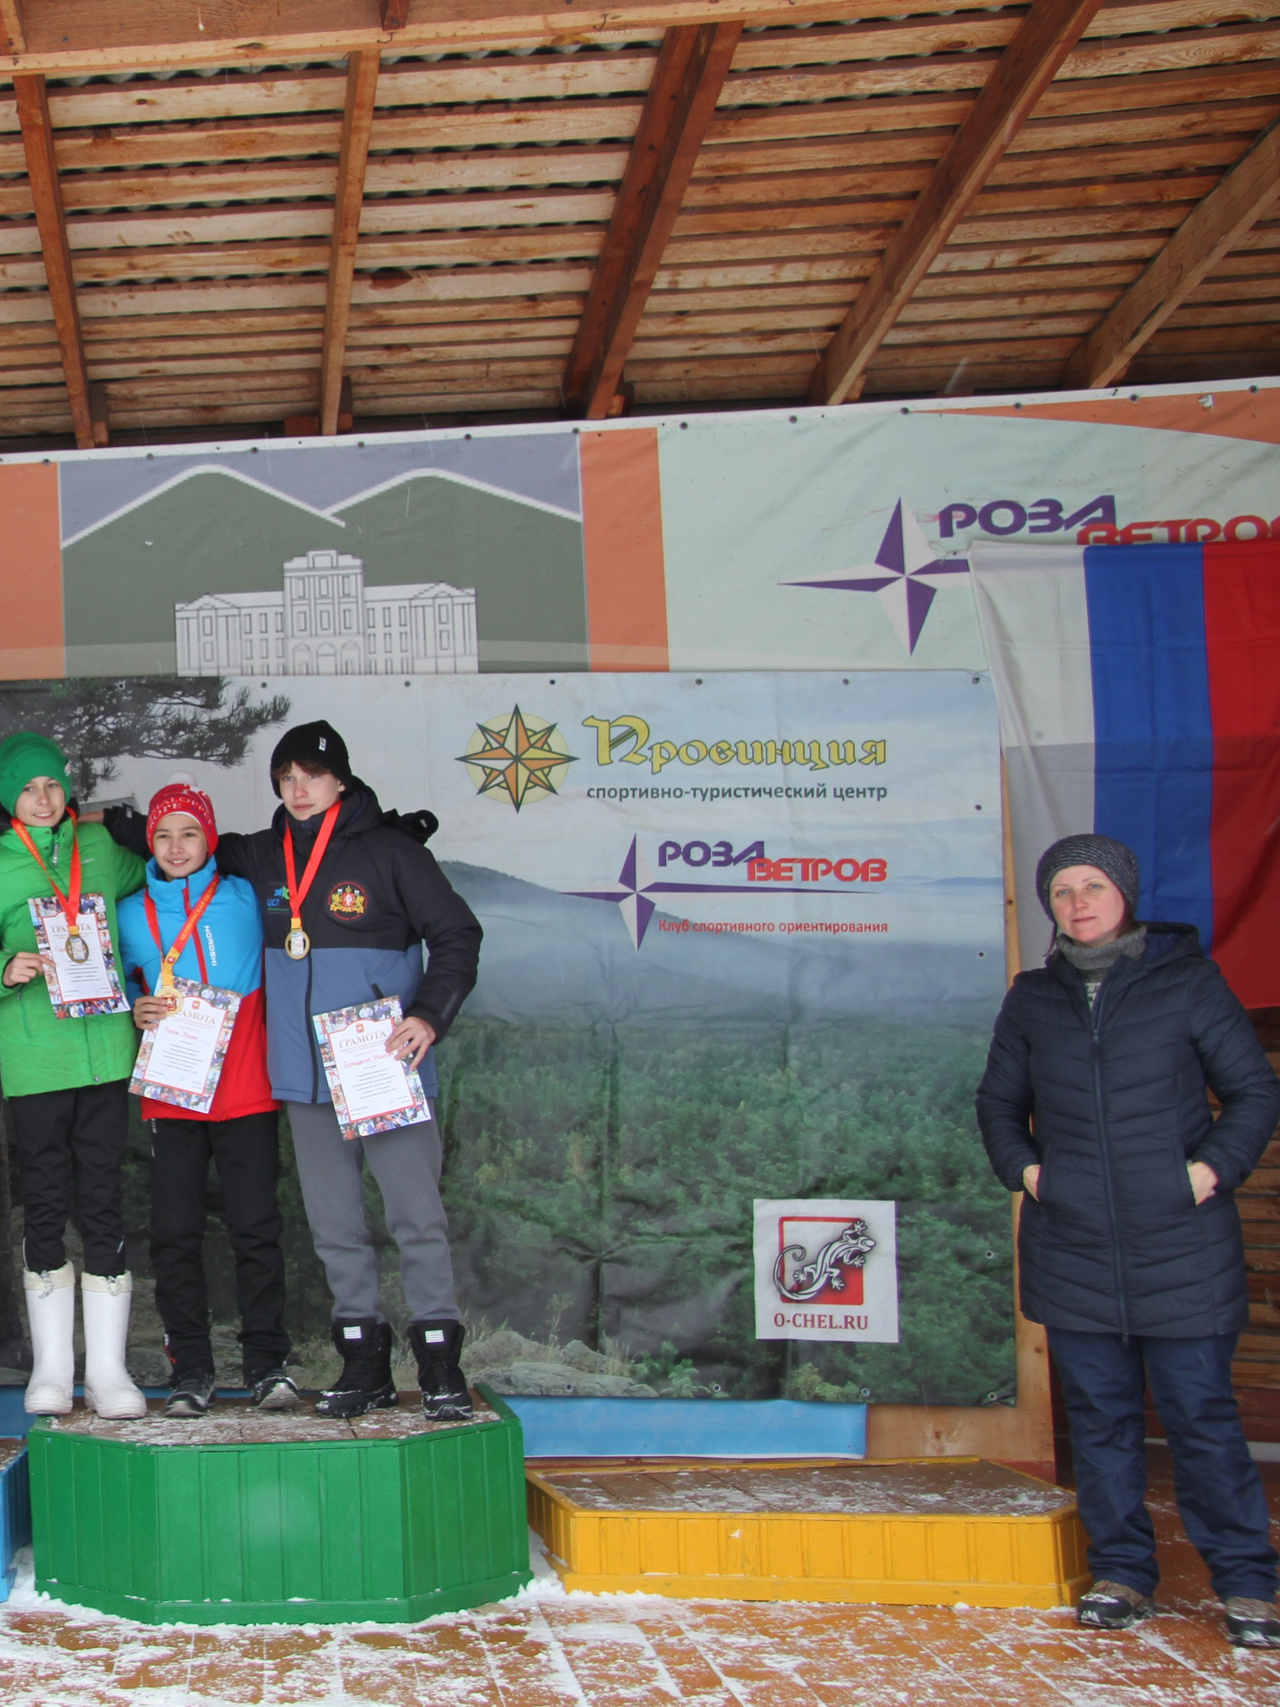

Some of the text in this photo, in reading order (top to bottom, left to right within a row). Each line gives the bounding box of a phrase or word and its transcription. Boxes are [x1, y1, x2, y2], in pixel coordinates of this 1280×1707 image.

[938, 495, 1117, 538] РОЗА
[1076, 514, 1280, 545] ВЕТРО
[581, 714, 887, 775] Провинция
[586, 783, 888, 802] спортивно-туристический центр
[658, 840, 765, 867] РОЗА
[746, 858, 888, 882] ВЕТРОВ
[658, 919, 888, 935] Клуб спортивного ориентирования
[204, 925, 218, 967] NORDSKI
[339, 1031, 388, 1048] ГРАМОТА
[773, 1312, 869, 1330] O-CHEL.RU
